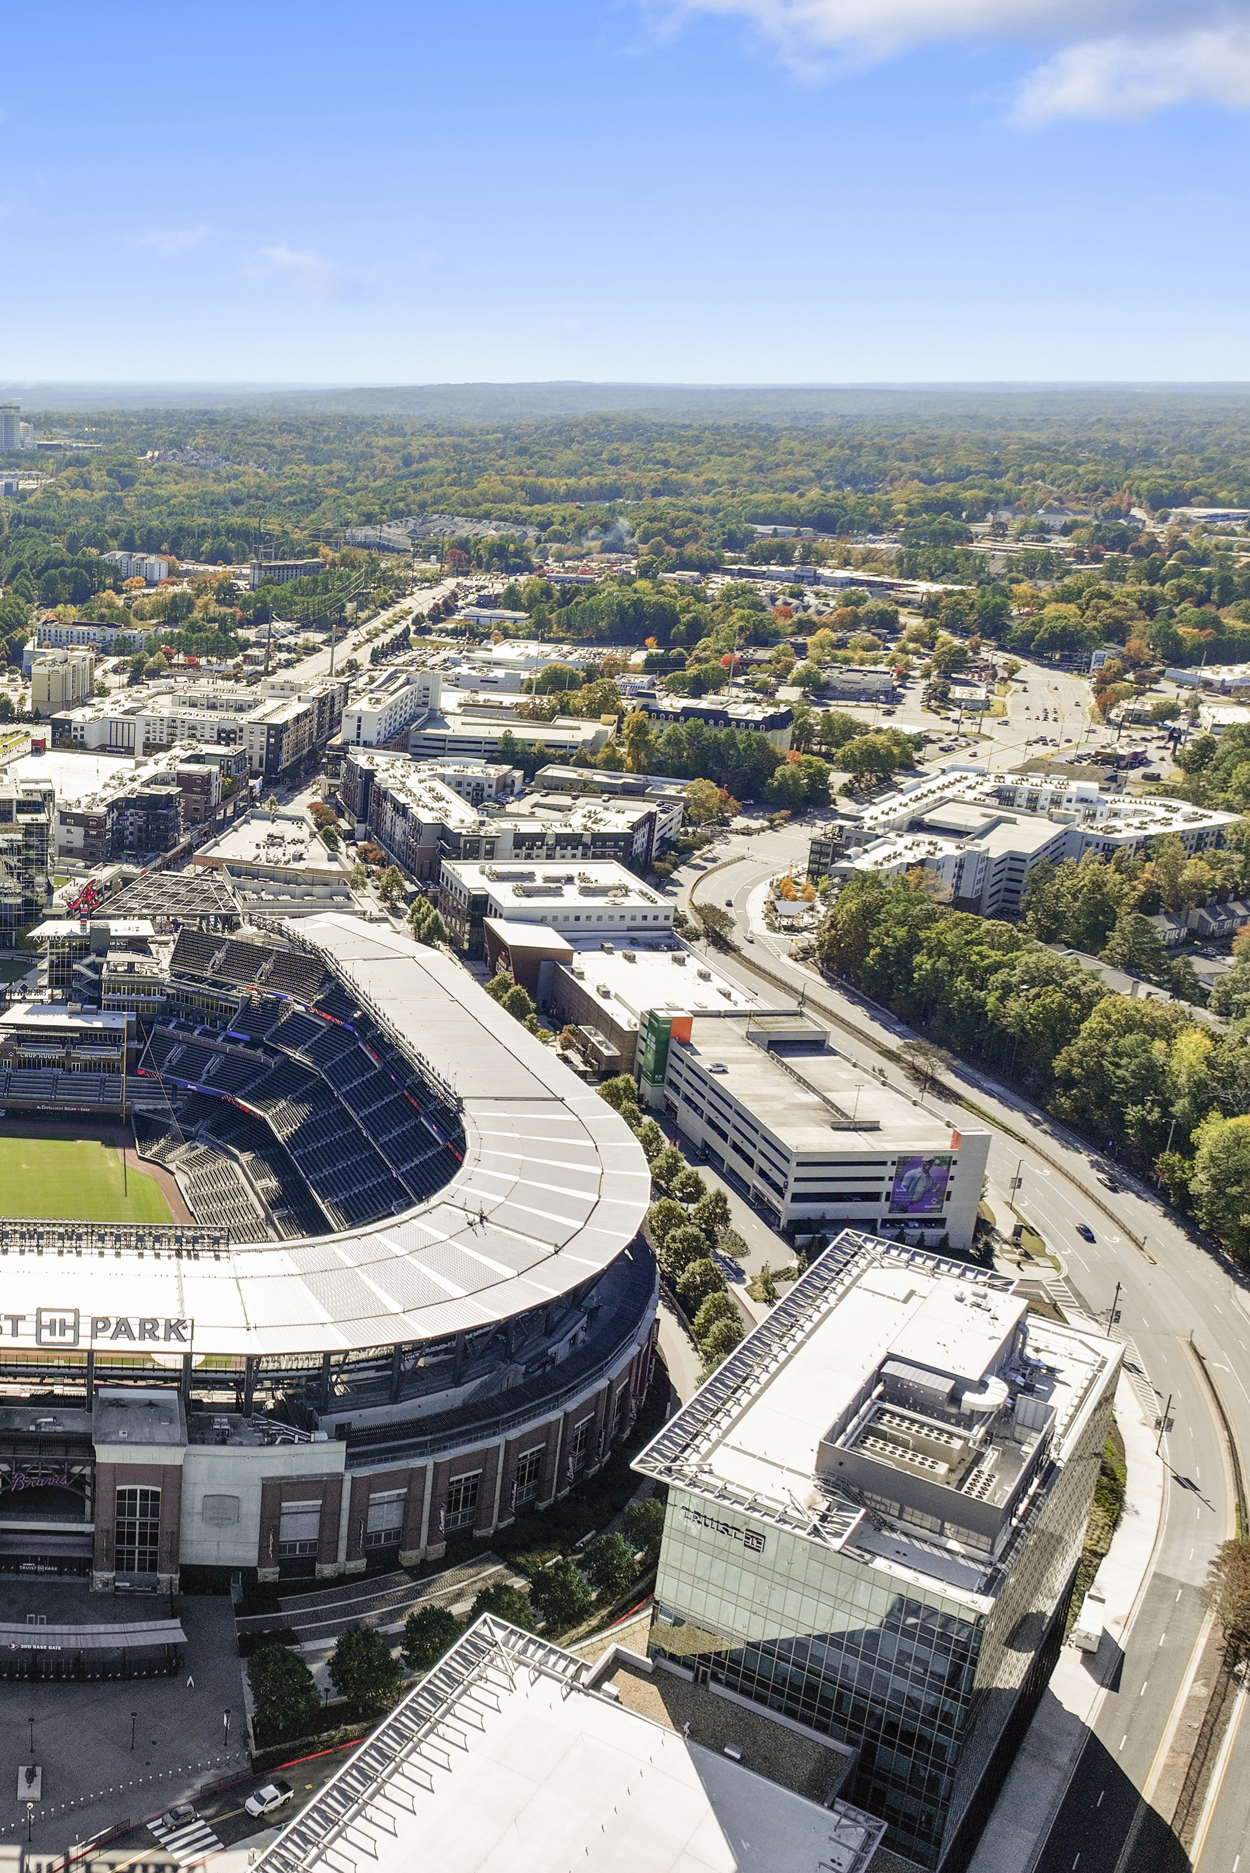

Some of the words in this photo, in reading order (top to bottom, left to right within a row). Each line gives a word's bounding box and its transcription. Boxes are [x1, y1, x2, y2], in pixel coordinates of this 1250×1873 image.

[91, 1317, 188, 1343] PARK
[11, 1473, 67, 1490] Braves
[681, 1507, 743, 1538] TRUIST
